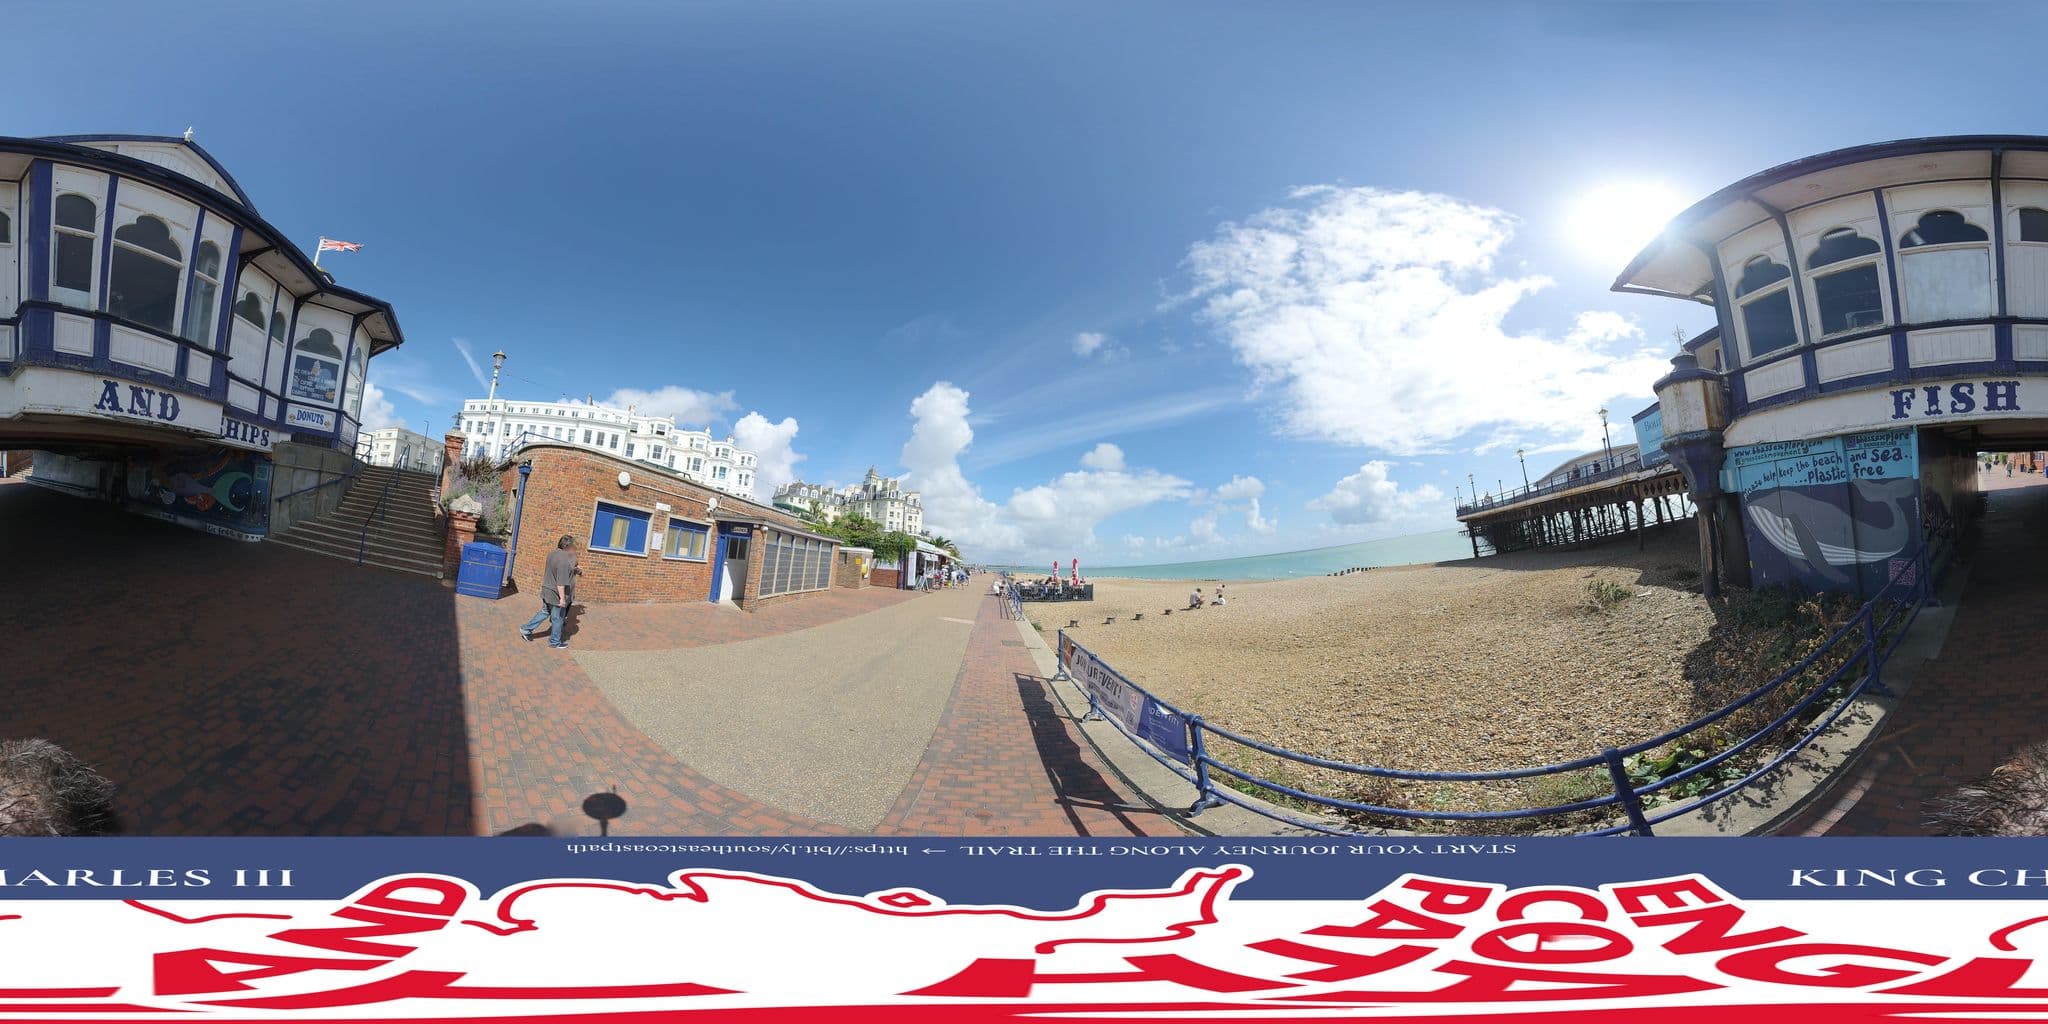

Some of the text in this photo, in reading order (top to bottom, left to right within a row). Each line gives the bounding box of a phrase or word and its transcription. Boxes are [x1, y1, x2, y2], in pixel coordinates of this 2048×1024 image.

[94, 379, 181, 422] AND
[1890, 381, 2021, 420] FISH
[296, 410, 324, 425] DONUTS
[221, 418, 269, 447] HIPS
[1796, 461, 1809, 472] the
[1812, 452, 1842, 467] beach
[1850, 450, 1867, 462] and
[1853, 463, 1886, 478] free
